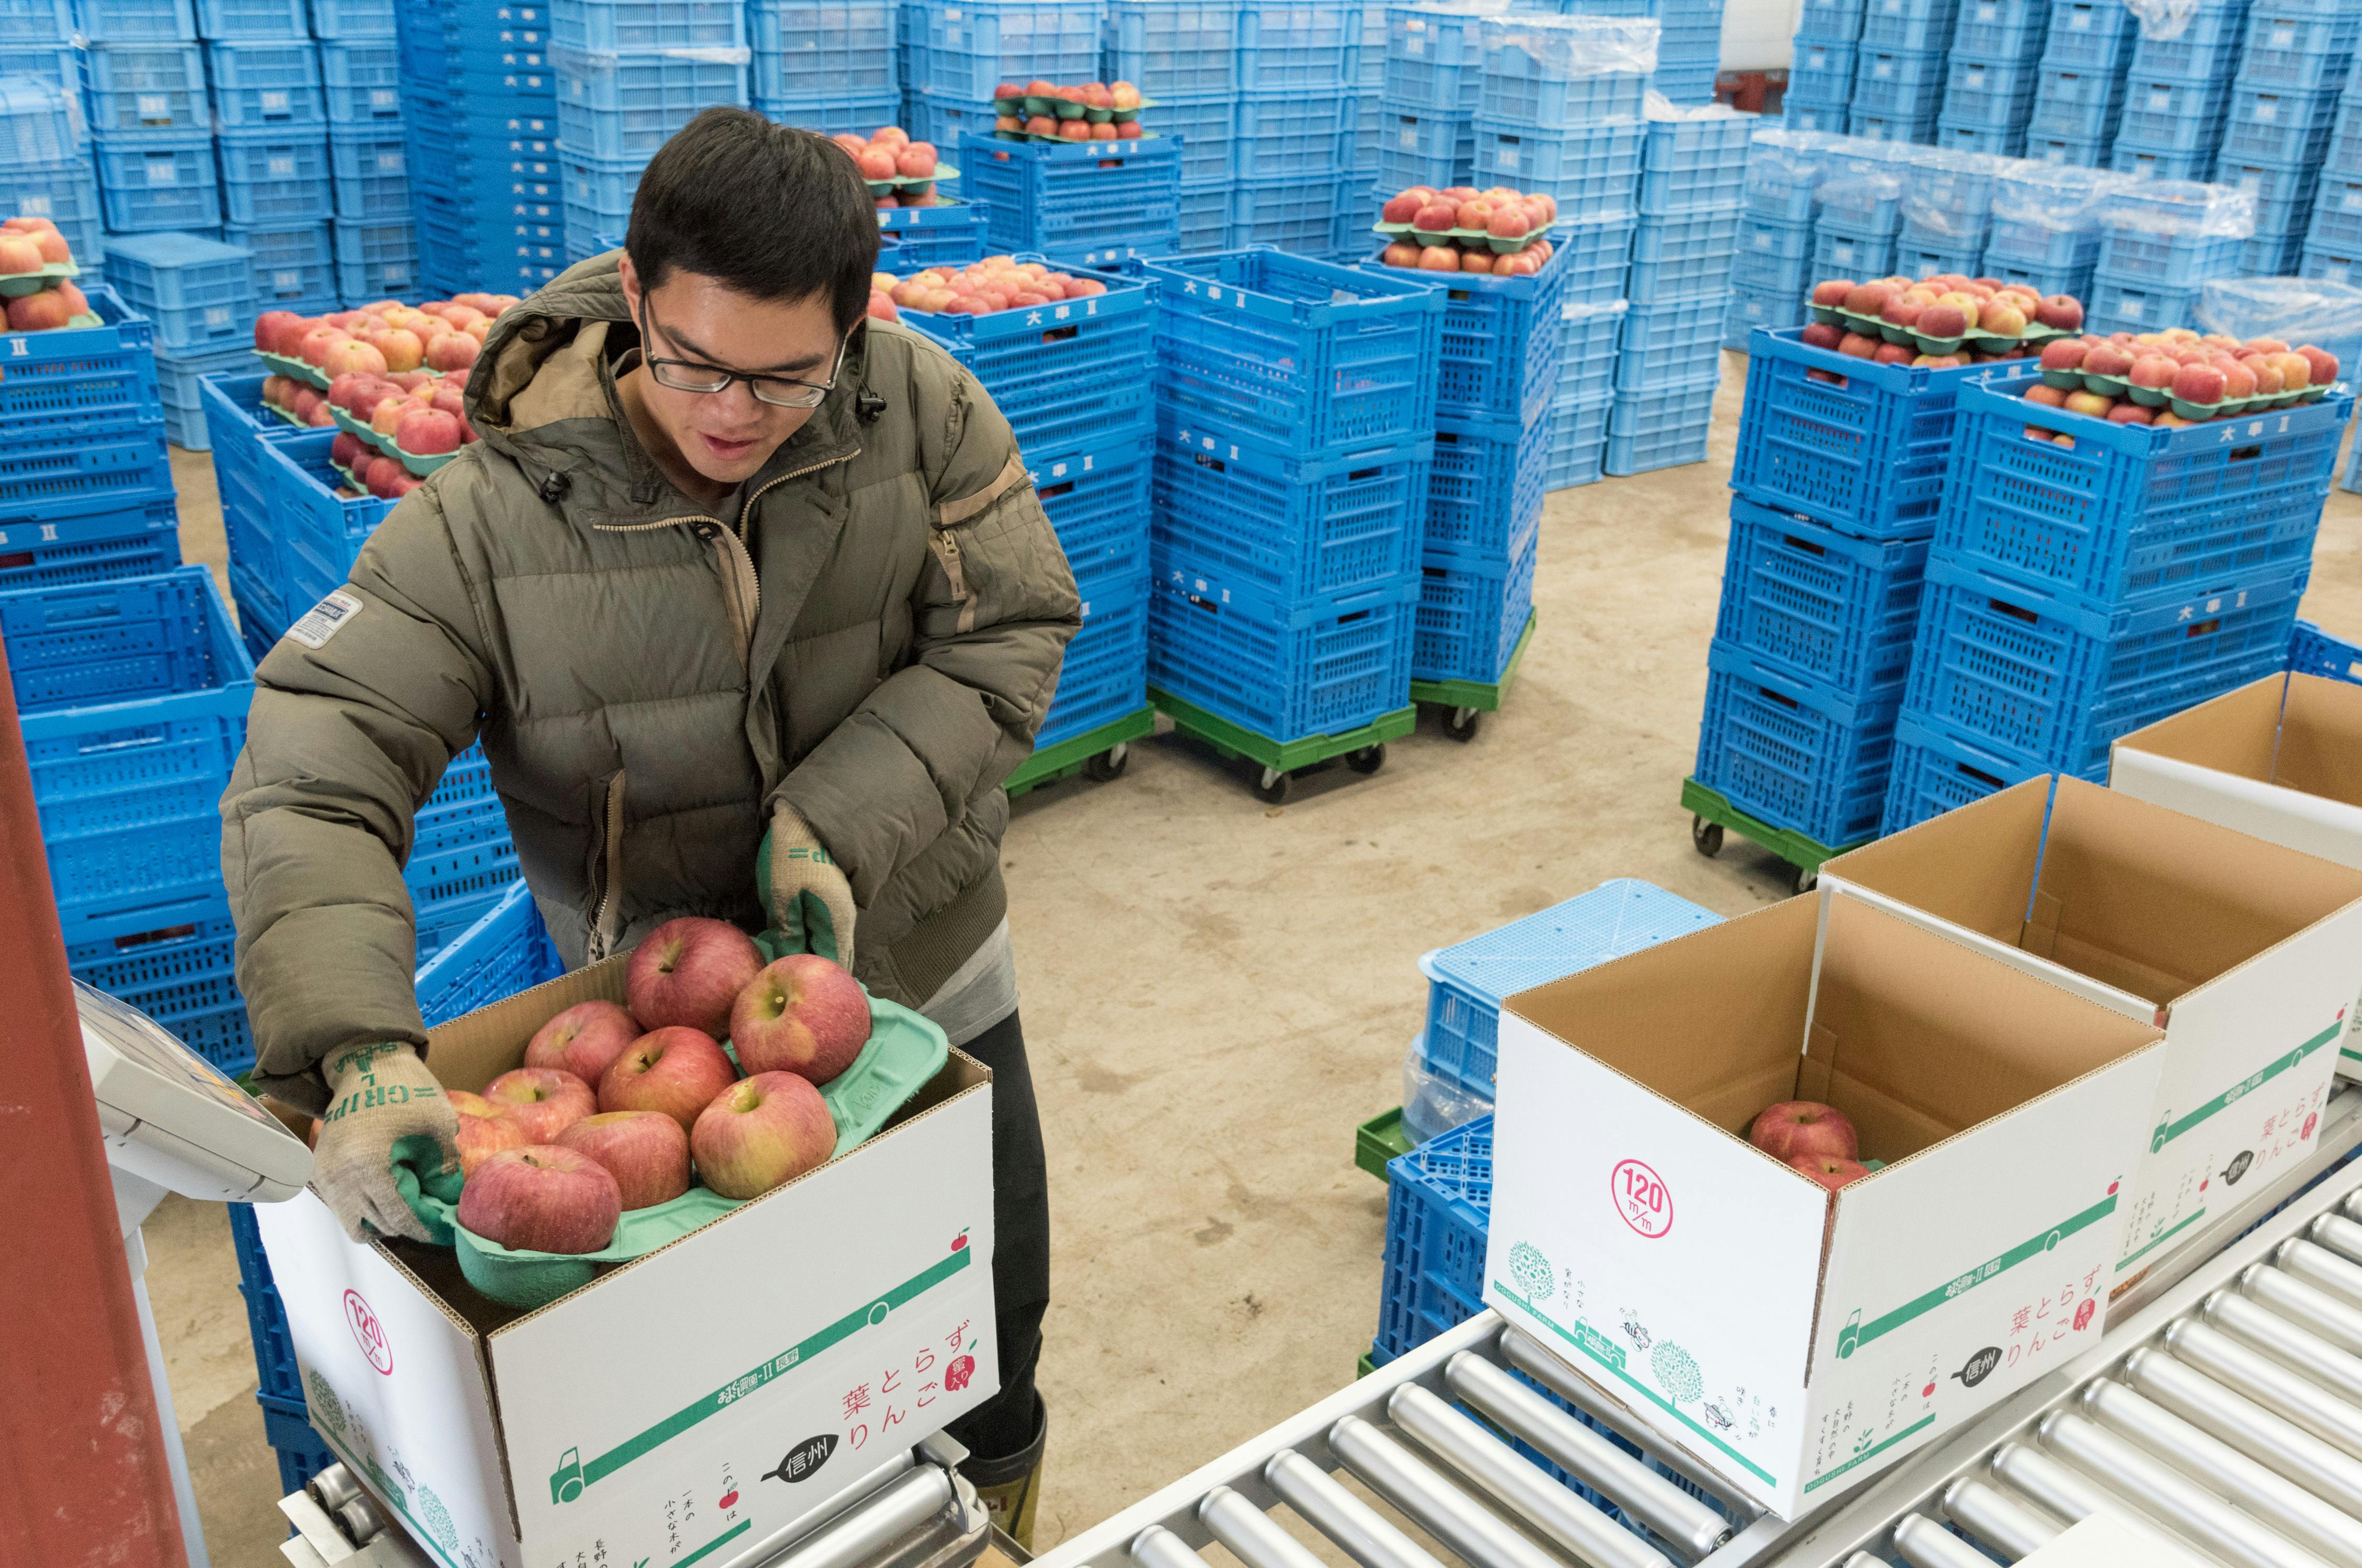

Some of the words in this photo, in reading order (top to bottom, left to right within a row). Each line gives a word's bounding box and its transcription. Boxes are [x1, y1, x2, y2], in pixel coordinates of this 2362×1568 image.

[1623, 1168, 1663, 1213] 120
[1628, 1200, 1652, 1232] m/m
[1495, 1283, 1531, 1312] OOGUSHI
[1532, 1309, 1555, 1329] FARM
[2009, 1264, 2102, 1337] 葉とらず
[349, 1298, 383, 1349] 120
[2008, 1317, 2070, 1368] りんご
[777, 1349, 798, 1370] 長野
[842, 1319, 970, 1421] 葉とらず
[1965, 1349, 1996, 1382] 信州
[850, 1381, 938, 1451] りんご
[785, 1437, 828, 1479] 信州
[1806, 1466, 1845, 1491] OOGUSHI
[1848, 1451, 1870, 1469] FARM
